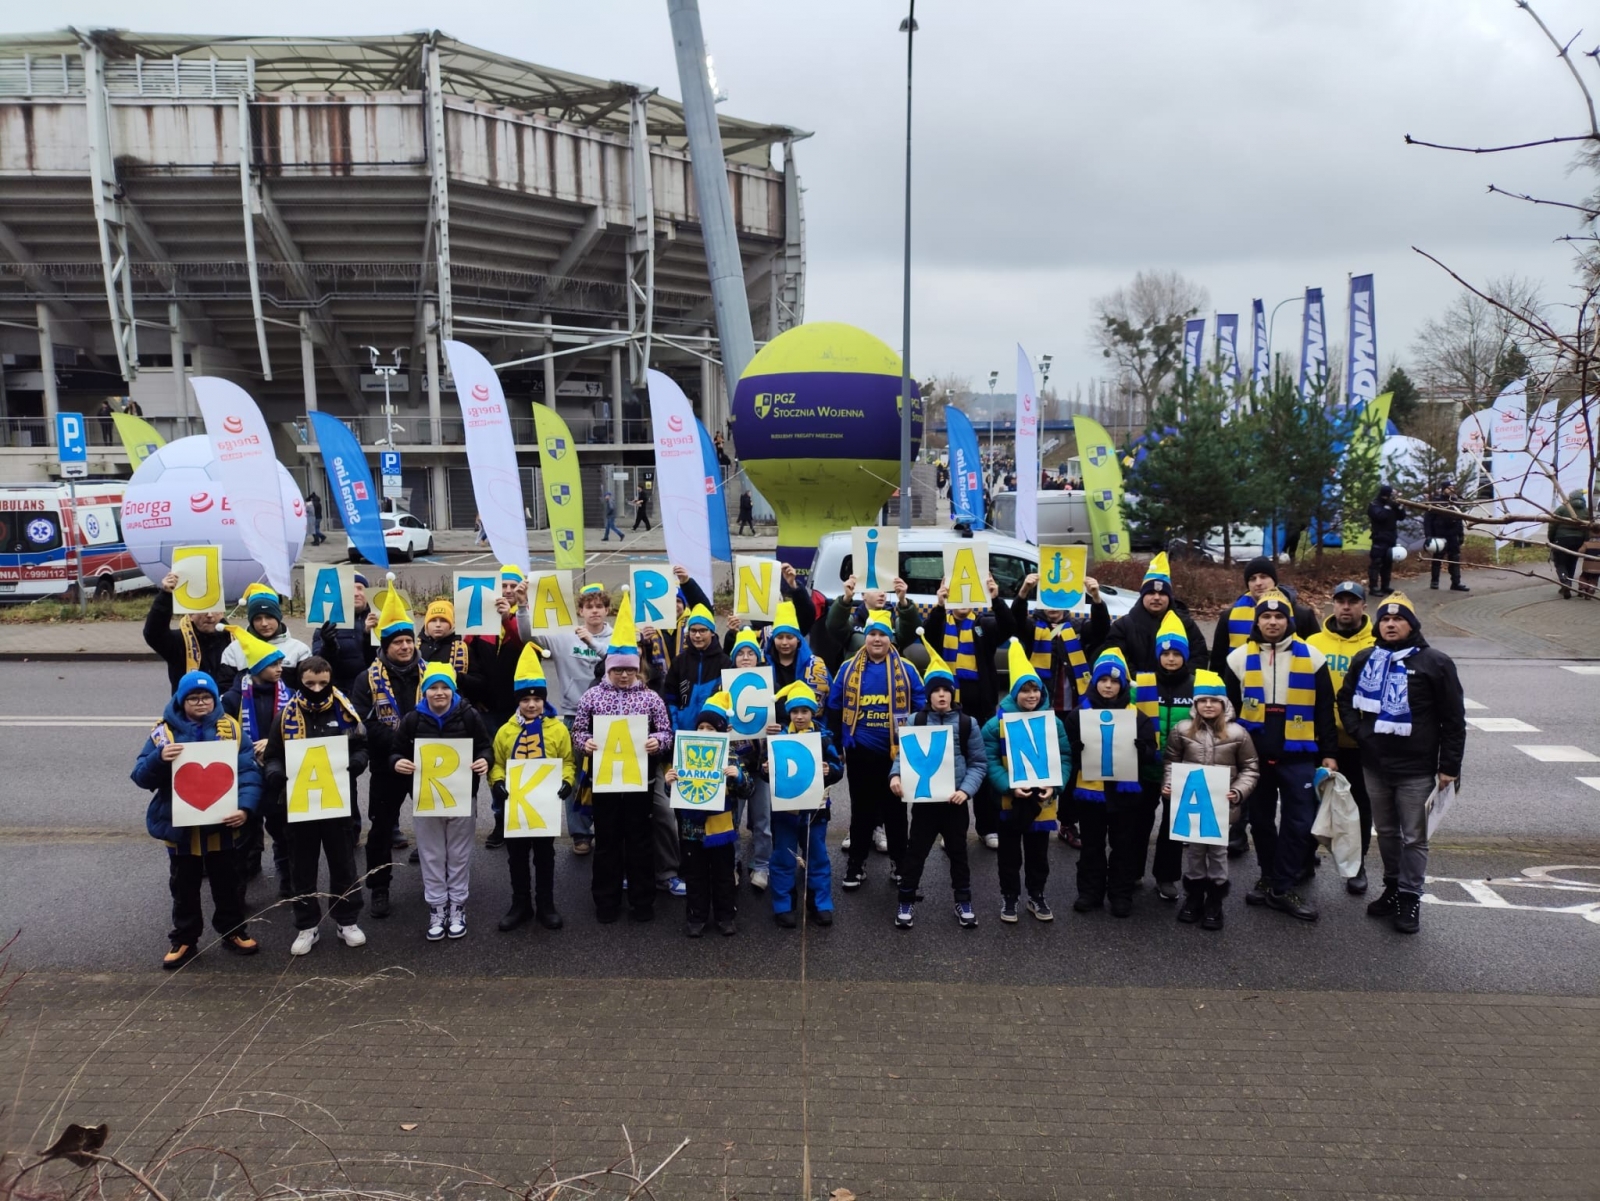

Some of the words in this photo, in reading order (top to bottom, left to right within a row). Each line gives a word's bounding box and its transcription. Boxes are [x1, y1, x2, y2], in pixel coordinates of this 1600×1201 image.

[1352, 291, 1376, 404] DYNIA
[774, 393, 796, 404] PGZ
[63, 418, 79, 447] P
[385, 454, 396, 468] P
[0, 500, 45, 511] BULANS
[126, 501, 171, 517] Energa
[144, 518, 170, 528] ORLEN
[174, 547, 220, 610] J
[308, 568, 345, 623] A
[458, 577, 495, 628] T
[533, 575, 573, 629] A
[633, 570, 669, 622] R
[737, 562, 773, 615] N
[947, 548, 986, 603] A
[729, 672, 768, 735] G
[595, 719, 642, 786] A
[771, 740, 815, 799] D
[900, 730, 948, 798] Y
[1006, 716, 1049, 782] N
[288, 745, 344, 813] A
[416, 743, 460, 811] R
[507, 764, 556, 831] K
[1172, 768, 1222, 838] A
